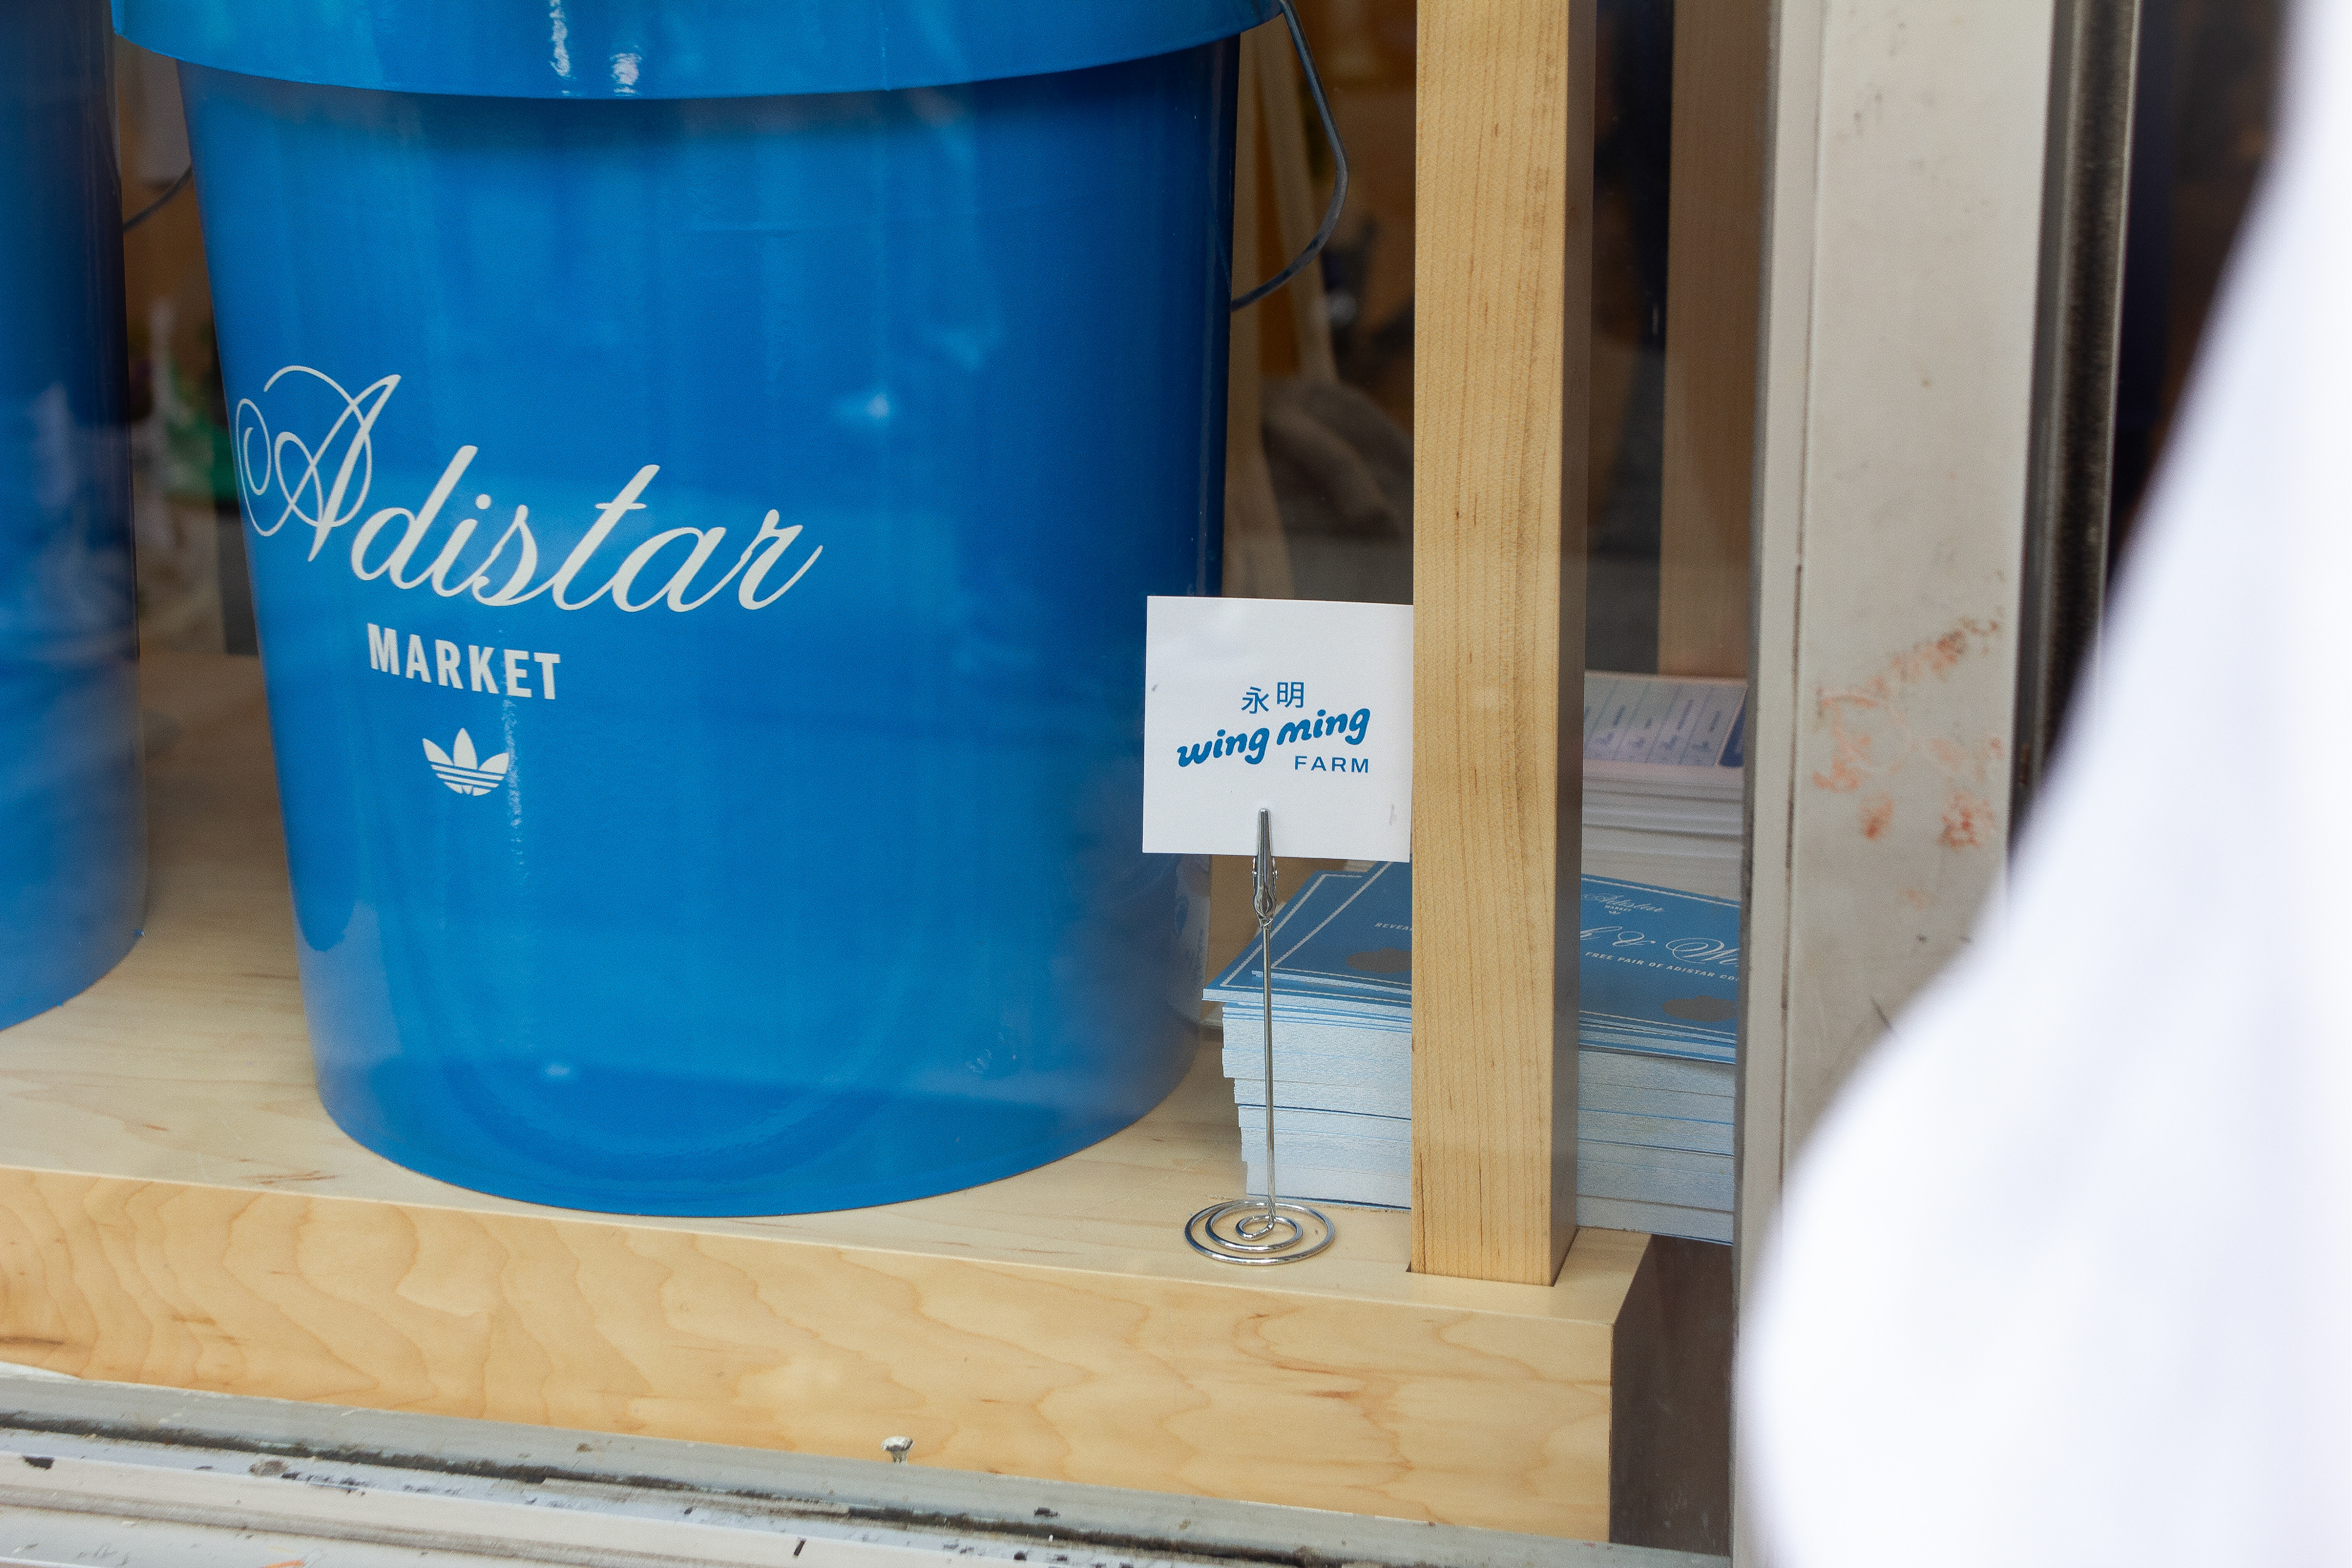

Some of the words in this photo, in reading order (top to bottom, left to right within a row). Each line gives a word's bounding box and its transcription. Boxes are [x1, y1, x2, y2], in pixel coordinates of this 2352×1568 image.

[236, 366, 823, 612] Adistar
[367, 623, 561, 700] MARKET
[1241, 681, 1304, 714] 永明
[1177, 727, 1270, 767] wing
[1276, 708, 1371, 745] ming
[1294, 755, 1369, 774] FARM
[1612, 931, 1656, 947] &
[1585, 951, 1614, 960] FREE
[1618, 957, 1645, 965] PAIR
[1666, 965, 1716, 978] ADISTAR
